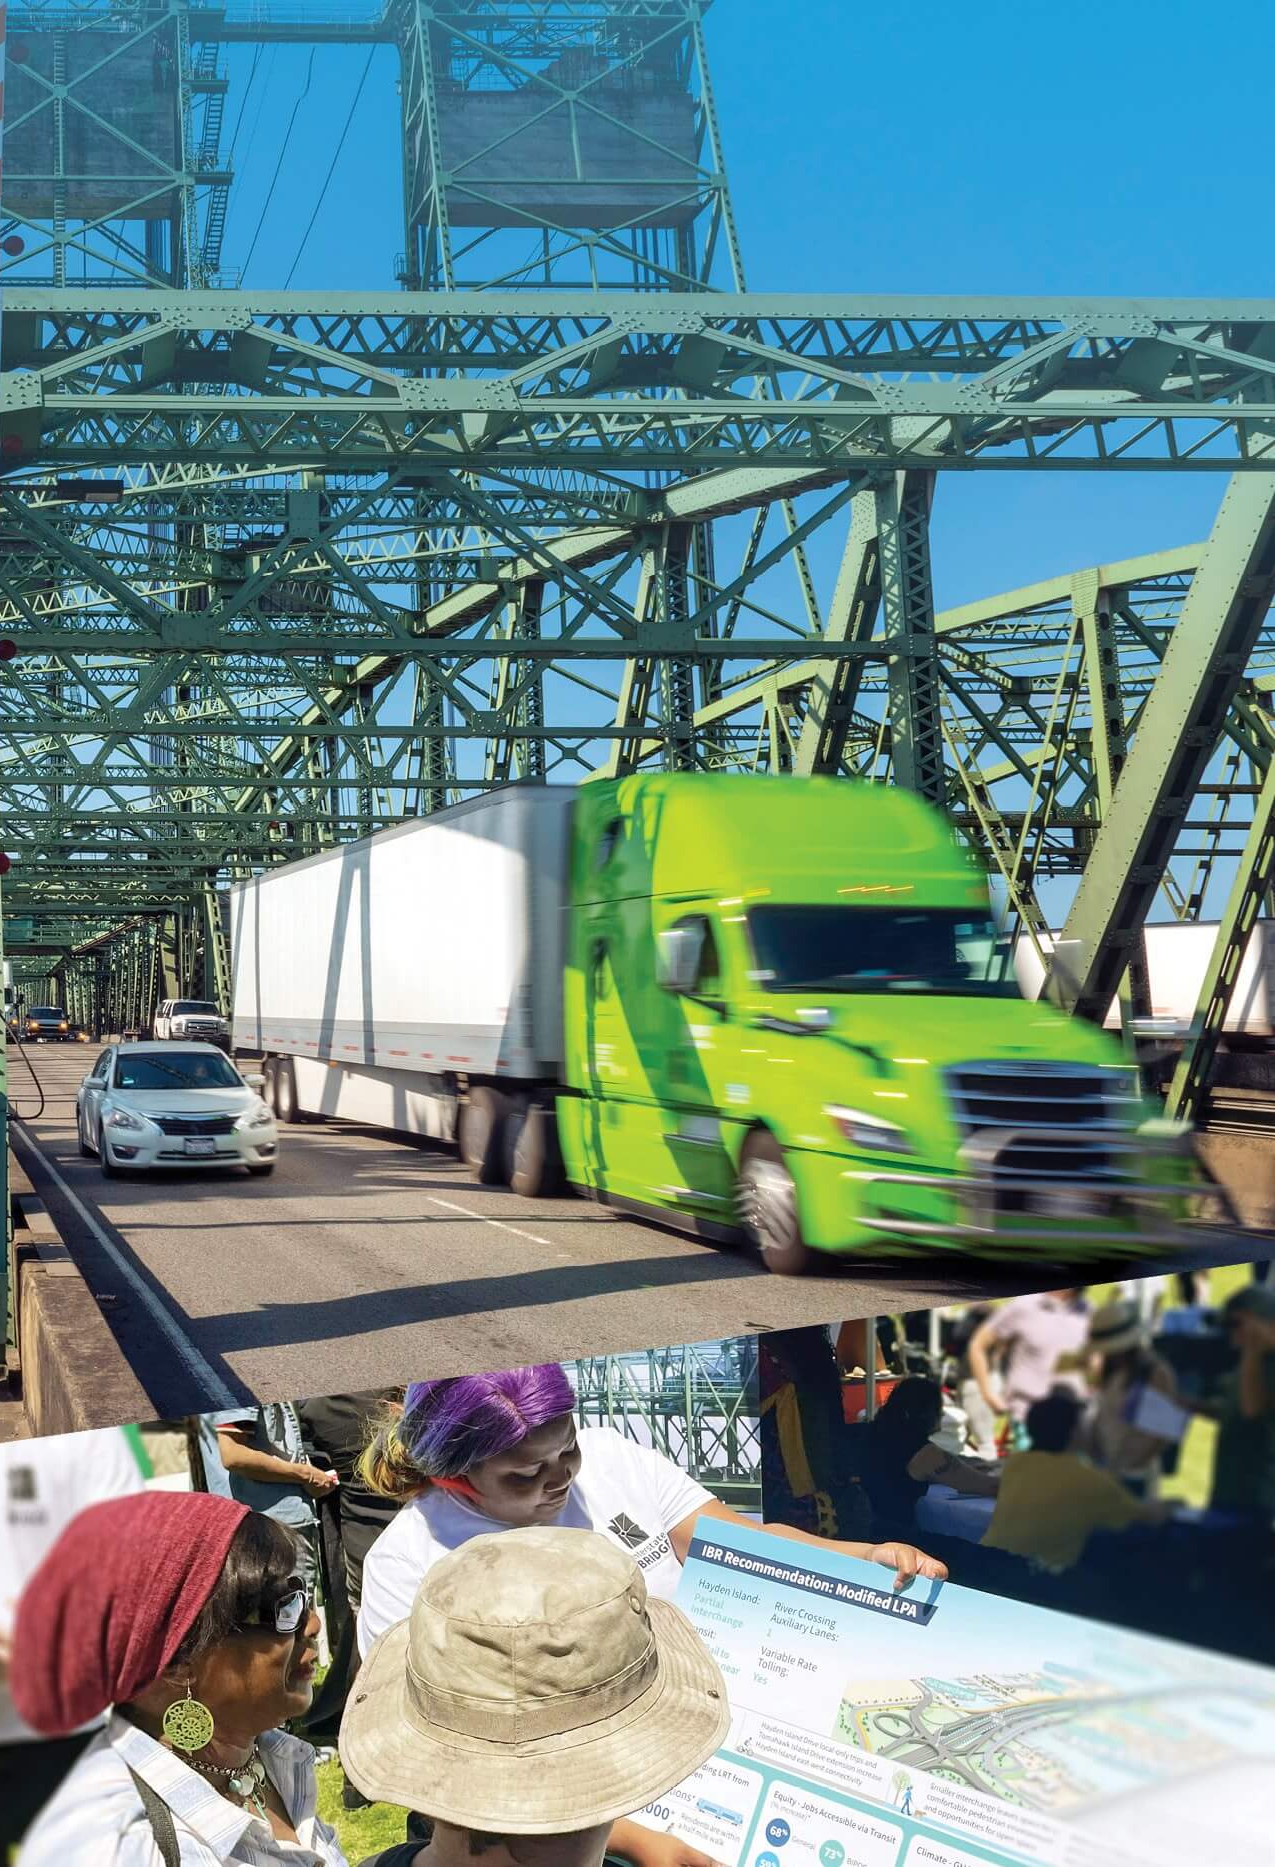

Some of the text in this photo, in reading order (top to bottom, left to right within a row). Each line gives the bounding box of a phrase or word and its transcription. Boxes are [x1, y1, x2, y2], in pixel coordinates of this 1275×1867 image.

[634, 1531, 666, 1559] nterstate
[699, 1579, 761, 1605] Hayden Island:
[702, 1544, 917, 1618] IBR Recommendation: Modified LPA
[694, 1593, 724, 1609] Partial
[770, 1614, 839, 1642] Auxiliary Lanes:
[775, 1602, 836, 1630] River Crossing
[758, 1658, 789, 1678] Tolling:
[760, 1646, 818, 1672] Variable Rate
[753, 1672, 768, 1685] Yes
[761, 1722, 784, 1736] Hayden
[756, 1741, 779, 1755] Hayden
[825, 1767, 863, 1786] connectivity
[759, 1732, 790, 1748] Tomahawk
[826, 1754, 856, 1772] extension
[701, 1763, 750, 1787] ding LRT from
[774, 1790, 797, 1806] Equity
[801, 1803, 818, 1815] Jobs
[819, 1810, 856, 1829] Accessible
[857, 1823, 869, 1834] via
[870, 1828, 896, 1845] Transit
[916, 1846, 948, 1865] Climate
